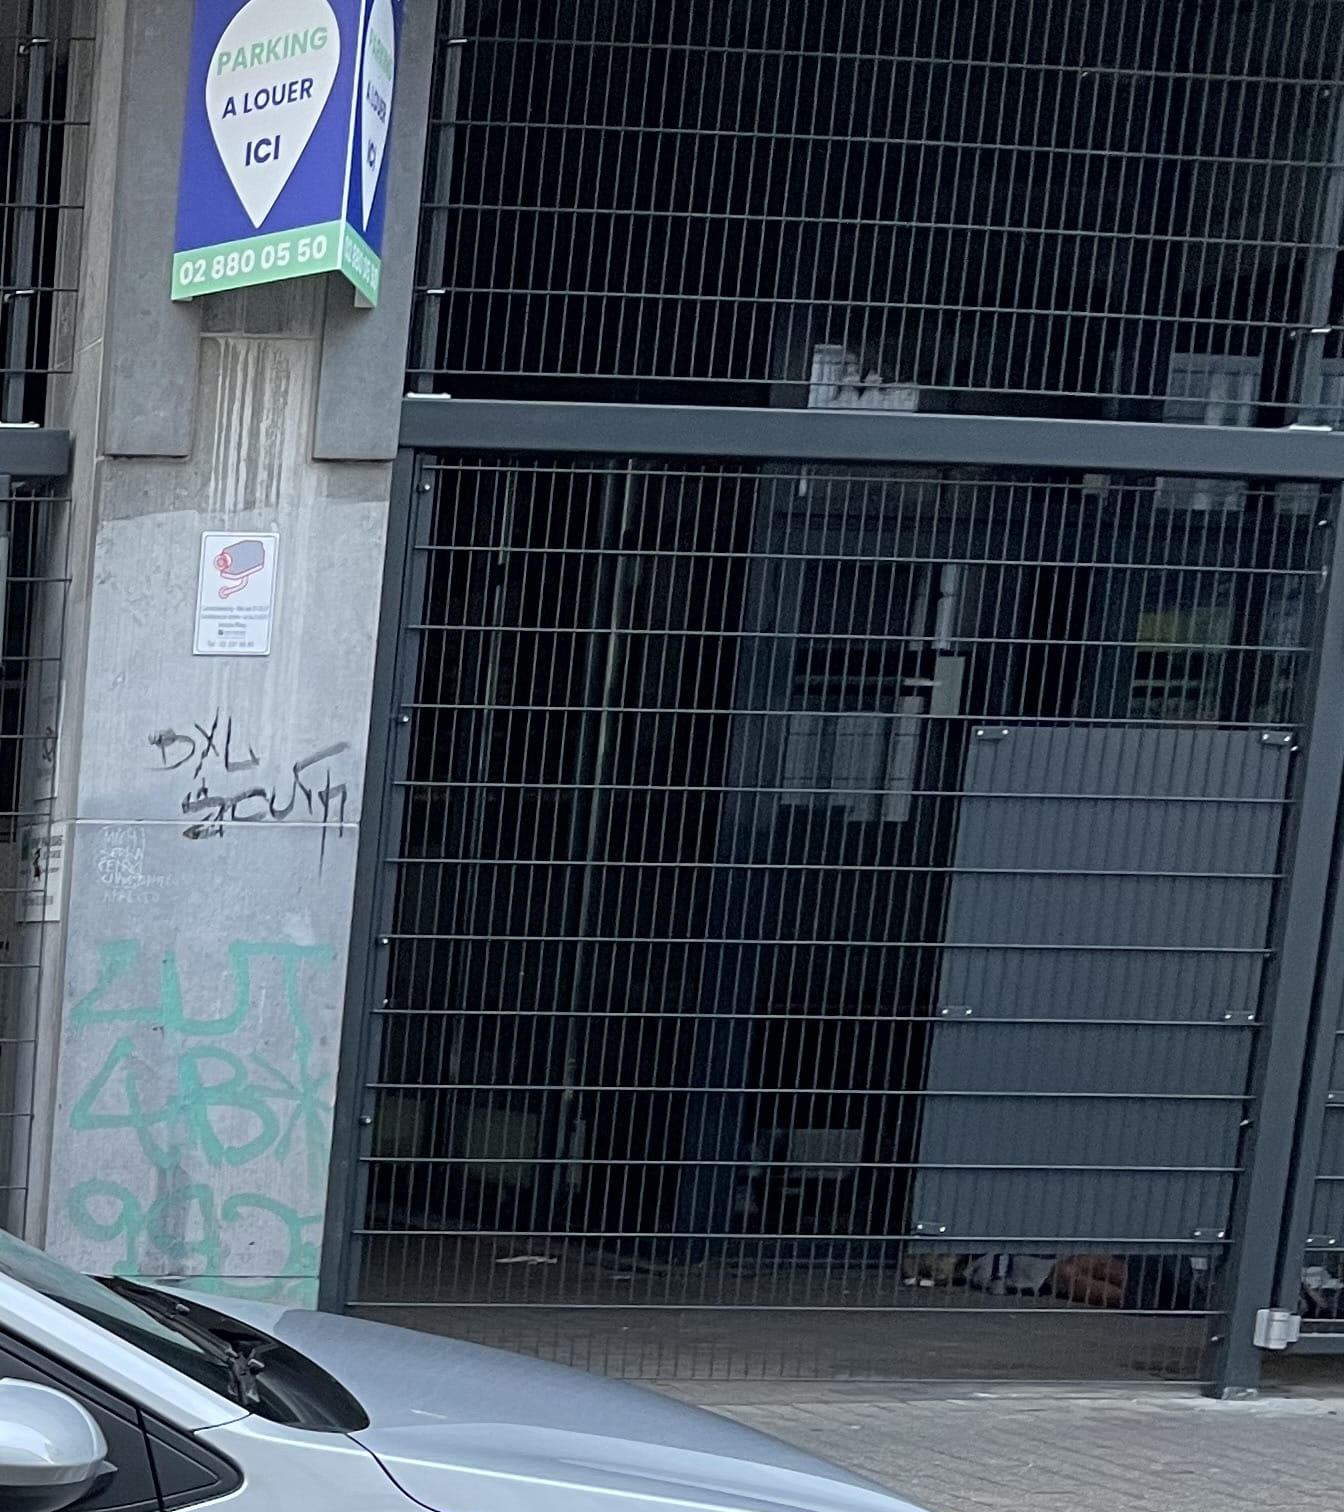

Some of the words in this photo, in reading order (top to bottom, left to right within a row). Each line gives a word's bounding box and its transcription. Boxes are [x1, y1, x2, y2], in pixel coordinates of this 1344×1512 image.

[217, 26, 328, 76] PARKING
[222, 96, 237, 120] A
[243, 78, 314, 114] LOUER
[245, 135, 281, 167] ICI
[179, 259, 207, 286] 02
[211, 248, 255, 280] 880
[260, 241, 291, 269] 05
[297, 234, 327, 263] 50
